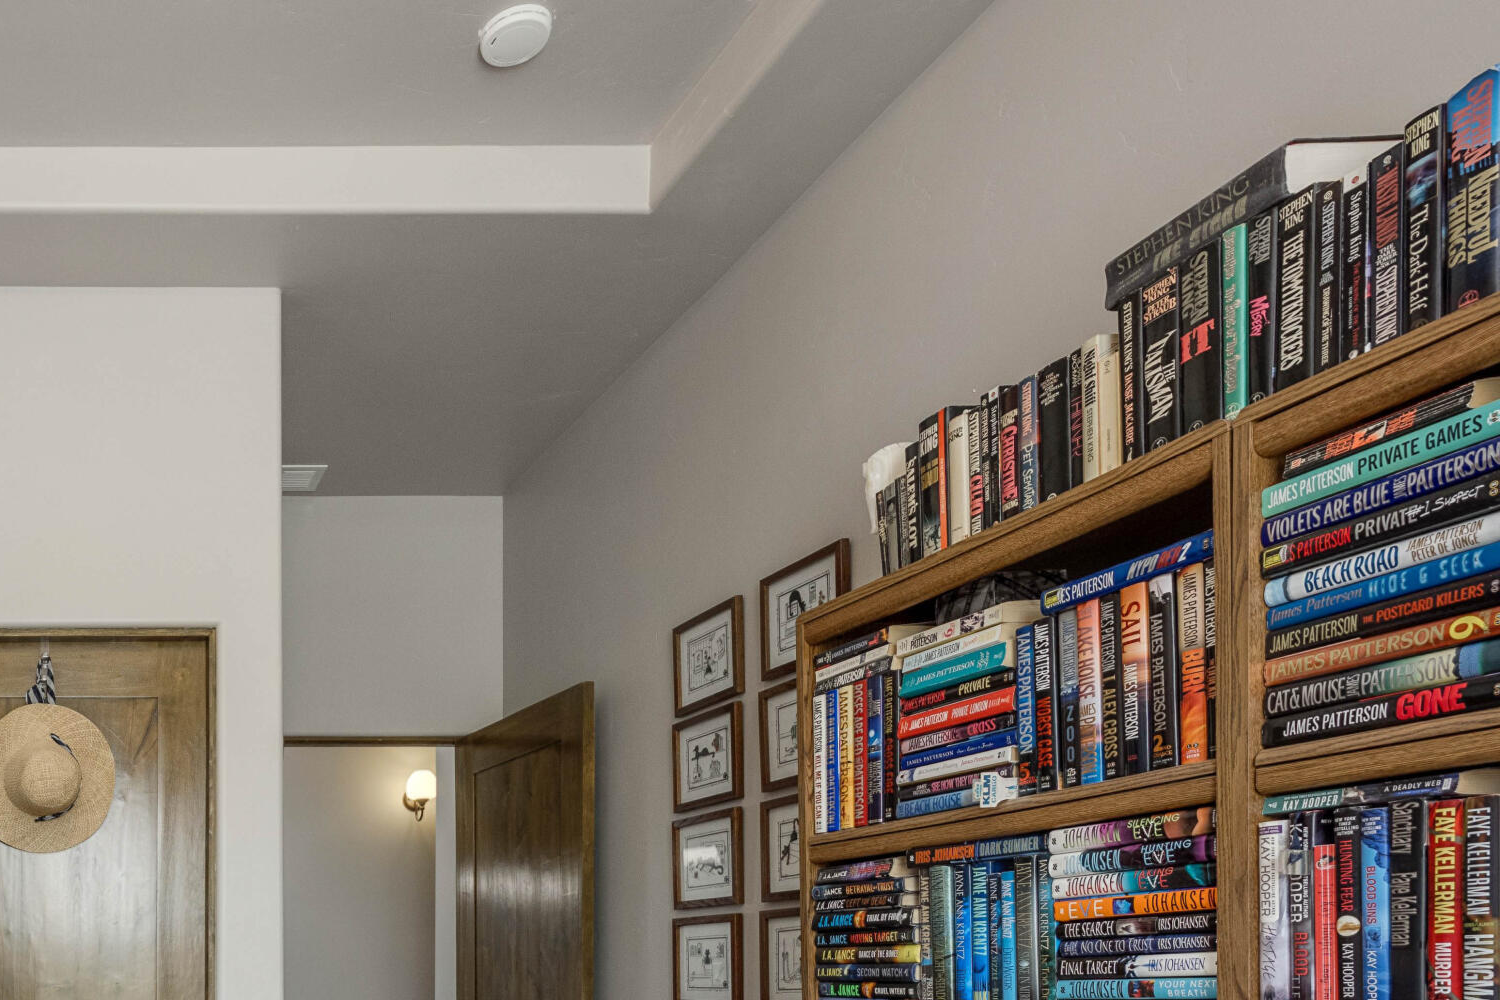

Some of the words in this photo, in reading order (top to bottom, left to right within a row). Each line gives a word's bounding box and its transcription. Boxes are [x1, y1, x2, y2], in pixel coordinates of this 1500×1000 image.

[1405, 110, 1439, 144] STEPHEN
[1452, 107, 1468, 163] KING
[1465, 78, 1493, 168] STEPHEN
[1411, 133, 1430, 158] KING
[1116, 213, 1193, 275] STEPHEN
[1198, 175, 1249, 222] KING
[1410, 203, 1429, 239] The
[1448, 188, 1467, 269] THINGS
[1467, 165, 1499, 265] NEEDFUL
[1410, 239, 1428, 278] Dark
[1182, 272, 1194, 320] KING
[1190, 251, 1209, 326] STEPHEN
[1410, 276, 1428, 315] Half
[1180, 318, 1215, 364] IT
[1145, 328, 1177, 424] TALISMAN
[1166, 359, 1175, 382] THE
[1002, 425, 1018, 504] CHRISTINE
[1268, 483, 1298, 509] JAMES
[1299, 462, 1354, 497] PATTERSON
[1358, 437, 1420, 475] PRIVATE
[1425, 415, 1483, 450] GAMES
[1406, 440, 1500, 496] PATTERSON
[1267, 507, 1322, 543] VIOLETS
[1323, 499, 1351, 525] ARE
[1353, 481, 1390, 512] BLUE
[1297, 526, 1352, 560] PATTERSON
[1071, 571, 1114, 600] PATTERSON
[1127, 554, 1159, 580] NYPD
[1178, 541, 1192, 562] 2
[1304, 558, 1354, 594] BEACH
[1355, 545, 1399, 580] ROAD
[1363, 614, 1374, 624] THE
[1376, 597, 1434, 623] POSTCARD
[1436, 583, 1485, 608] KILLERS
[1121, 601, 1141, 653] SAIL
[1269, 631, 1301, 654] JAMES
[1302, 614, 1359, 645] PATTERSON
[1270, 657, 1325, 683] JAMES
[1329, 622, 1446, 666] PATTERSON
[1036, 696, 1051, 735] WORST
[1283, 717, 1320, 737] JAMES
[1322, 702, 1389, 729] PATTERSON
[1396, 682, 1468, 721] GONE
[1037, 736, 1053, 768] CASE
[982, 774, 991, 805] KLM
[1282, 800, 1299, 811] KAY
[1302, 795, 1338, 808] HOOPER
[1392, 782, 1422, 791] DEADLY
[1424, 779, 1441, 787] WEB
[1062, 825, 1121, 849] JOHANSEN
[1127, 813, 1180, 828] SILENCING
[1132, 825, 1163, 842] EVE
[1434, 807, 1456, 843] FAYE
[1467, 807, 1491, 838] FAYE
[1340, 840, 1353, 885] HUNTING
[1467, 842, 1491, 915] KELLERMAN
[1143, 887, 1217, 913] JOHANSEN
[1341, 887, 1354, 912] FEAR
[1366, 866, 1376, 900] BLOOD
[1434, 846, 1455, 934] KELLERMAN
[1068, 899, 1104, 919] EVE
[1366, 902, 1377, 924] SINS
[1060, 960, 1084, 976] FINAL
[1086, 960, 1118, 974] TARGET
[1149, 960, 1163, 971] IRIS
[1164, 957, 1205, 971] JOHANSEN
[1342, 943, 1354, 960] KAY
[1367, 950, 1377, 969] KAY
[1434, 942, 1452, 994] MURDER
[827, 967, 843, 977] JANCE
[856, 967, 880, 977] SECOND
[881, 966, 904, 977] WATCH
[1342, 962, 1355, 998] HOOPER
